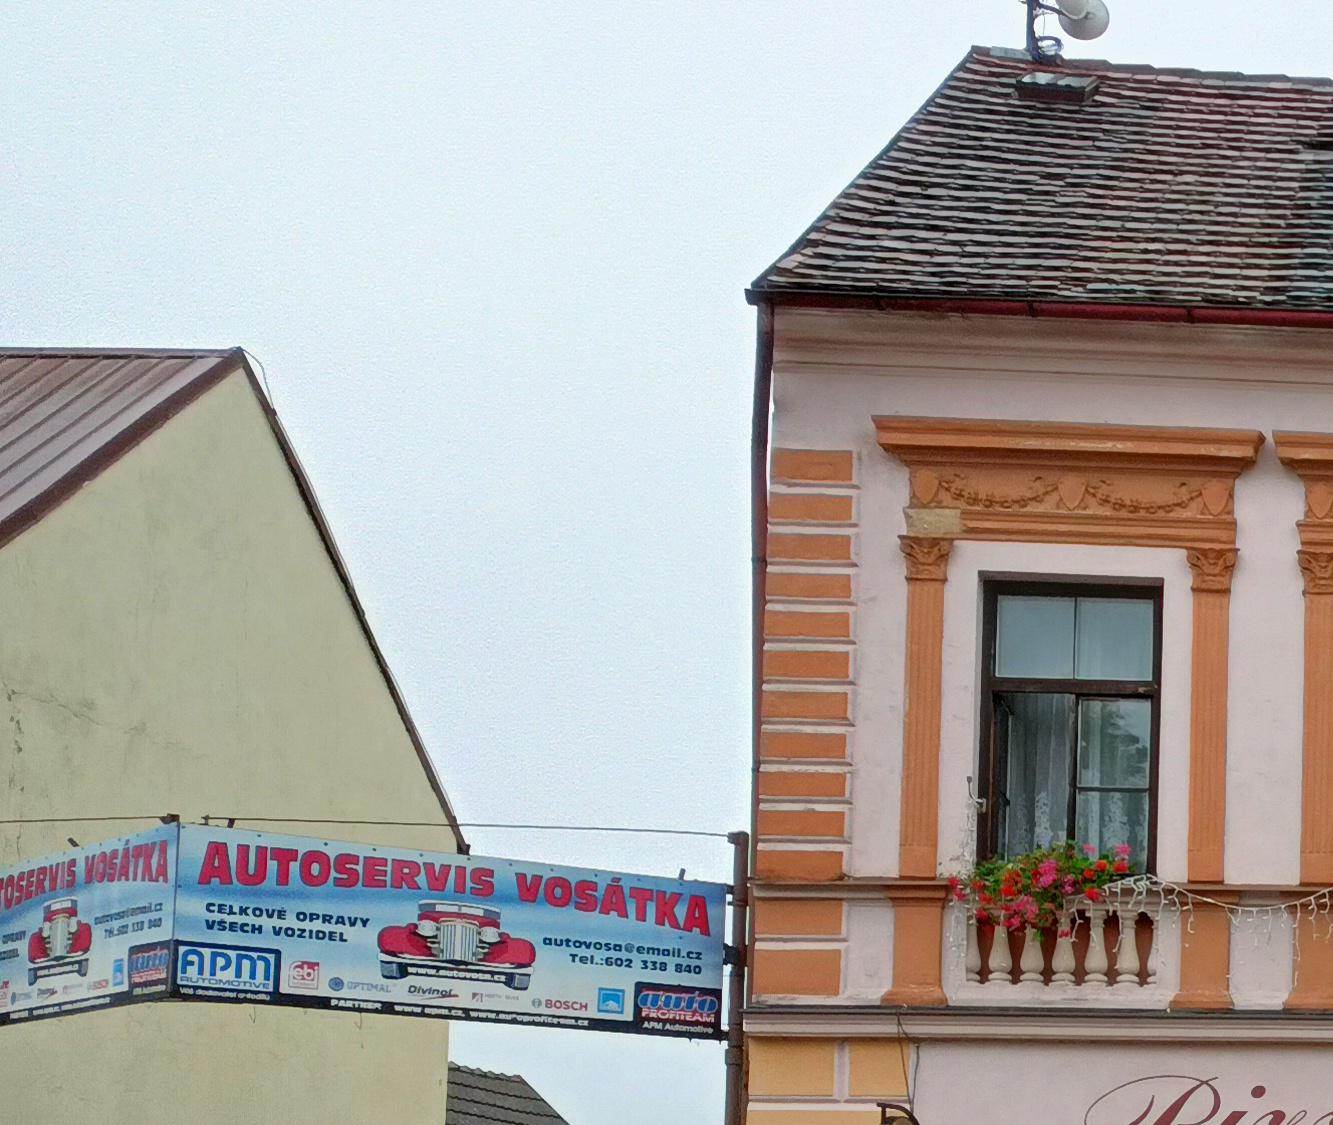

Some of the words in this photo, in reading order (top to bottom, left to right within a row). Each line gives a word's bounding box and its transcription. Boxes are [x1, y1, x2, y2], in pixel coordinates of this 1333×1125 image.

[84, 839, 169, 884] VOSÁTKA
[198, 841, 495, 897] AUTOSERVIS
[515, 877, 711, 937] VOSÁTKA
[205, 902, 288, 921] CELKOVÉ
[295, 911, 371, 928] OPRAVY
[205, 918, 263, 935] VŠECH
[272, 925, 348, 943] VOZIDEL
[542, 935, 703, 961] autovosa@email.cz
[180, 948, 272, 982] APM
[569, 953, 634, 969] Tel.:602
[640, 959, 669, 973] 338
[674, 963, 703, 976] 840
[179, 976, 270, 990] AUTOMOTIVE
[407, 984, 453, 997] Divinol
[544, 998, 589, 1012] BOSCH
[641, 1008, 715, 1023] PROFITEAM
